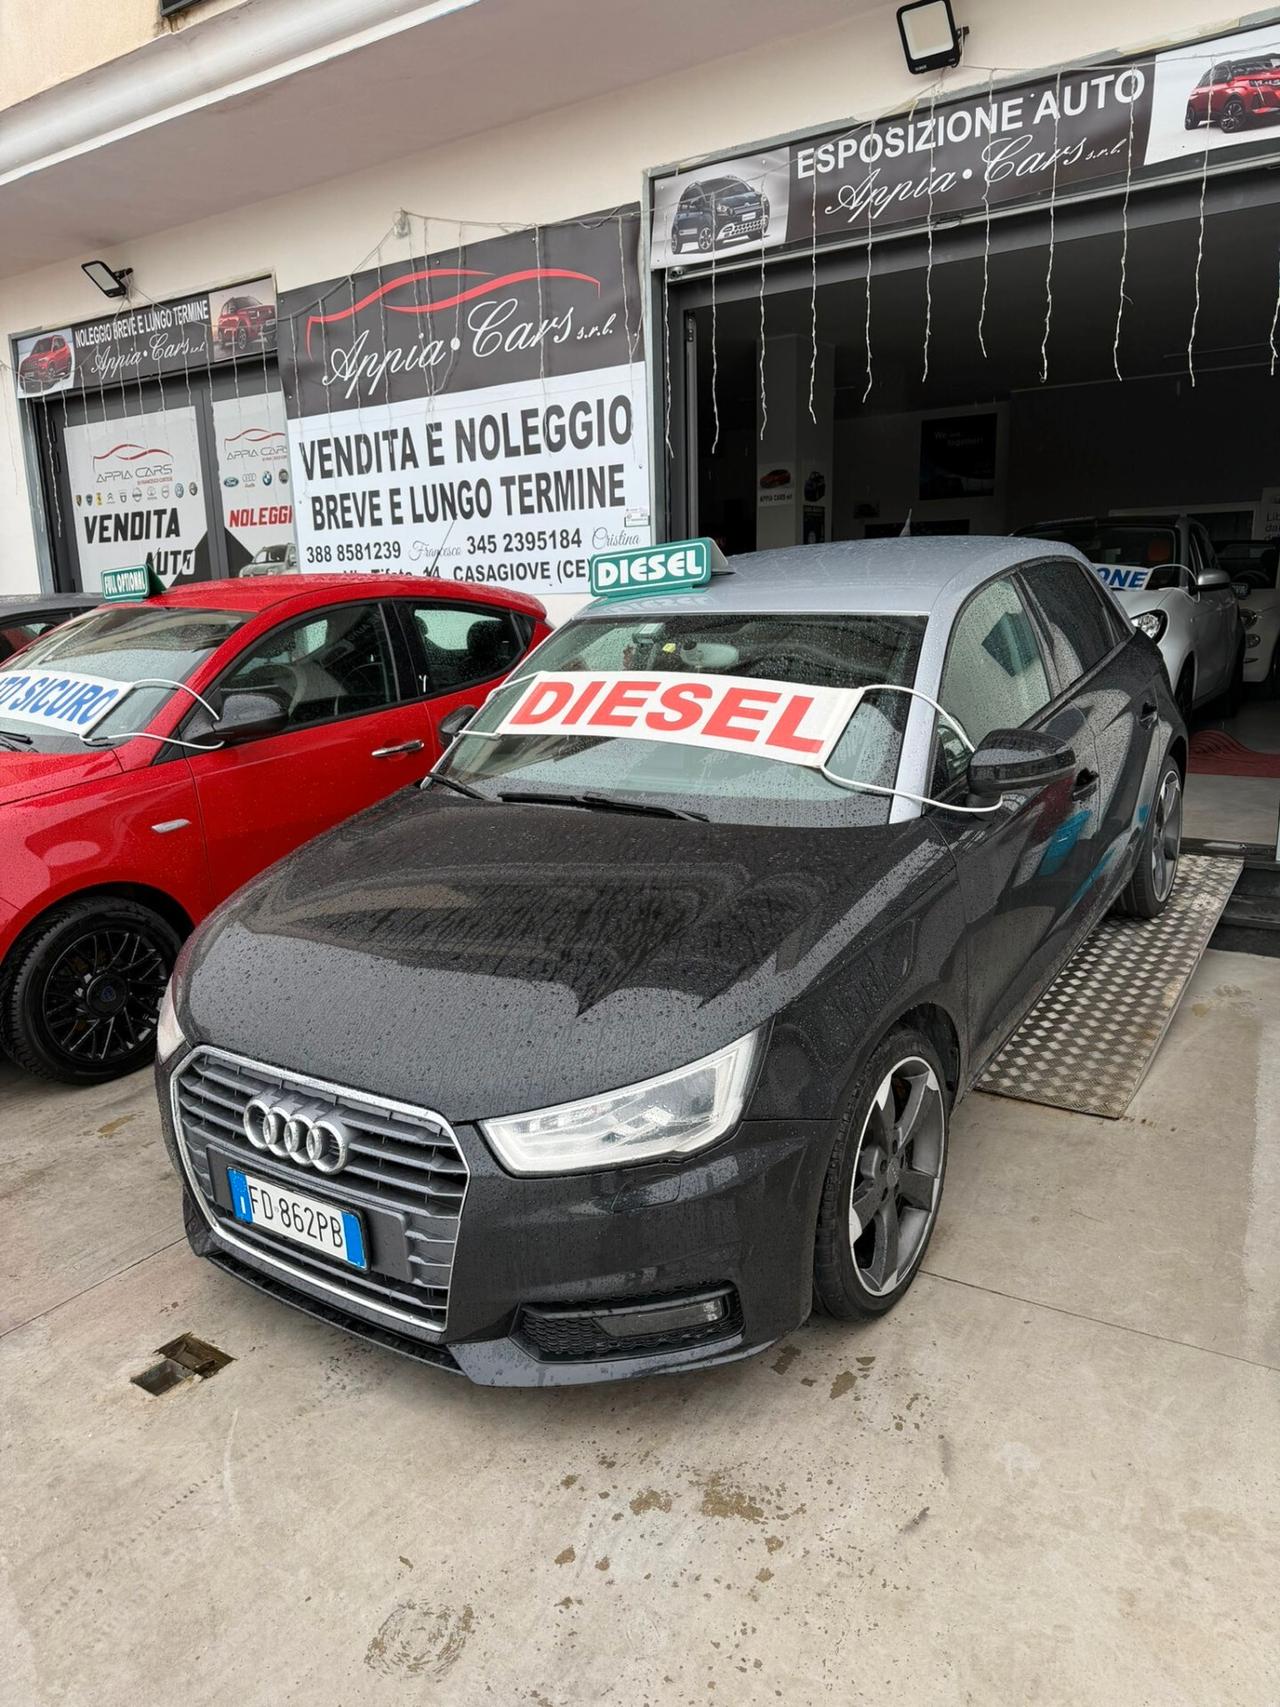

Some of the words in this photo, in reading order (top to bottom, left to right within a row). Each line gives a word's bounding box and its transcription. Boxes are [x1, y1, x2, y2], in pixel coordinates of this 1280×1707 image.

[797, 97, 1024, 180] ESPOSIZIONE
[1032, 69, 1146, 125] AUTO
[825, 168, 957, 223] Appia
[981, 134, 1087, 183] Cars
[75, 323, 112, 348] NOLEGGIO
[113, 319, 137, 340] BREVE
[137, 316, 145, 334] E
[144, 309, 172, 333] LUNGO
[173, 300, 209, 326] TERMINE
[91, 346, 142, 379] Appia
[149, 333, 190, 360] Cars
[322, 330, 447, 399] Appia
[467, 298, 575, 358] Cars
[227, 448, 258, 461] APPIA
[299, 427, 419, 481] VENDITA
[425, 422, 445, 466] E
[455, 394, 634, 464] NOLEGGIO
[96, 470, 133, 483] APPIA
[135, 463, 173, 478] CARS
[311, 489, 383, 531] BREVE
[389, 486, 404, 525] E
[410, 477, 493, 524] LUNGO
[500, 463, 626, 516] TERMINE
[84, 507, 181, 545] VENDITA
[307, 545, 332, 563] 388
[337, 540, 401, 562] 8581239
[467, 534, 497, 554] 345
[503, 527, 582, 552] 2395184
[592, 526, 641, 550] Cristina
[146, 548, 196, 576] AUTO
[453, 561, 551, 583] CASAGIOVE
[557, 558, 591, 584] (CE)
[597, 549, 702, 587] DIESEL
[8, 676, 119, 725] SICURO
[509, 680, 825, 753] DIESEL
[248, 1185, 274, 1220] FD
[278, 1198, 344, 1249] 862PB
